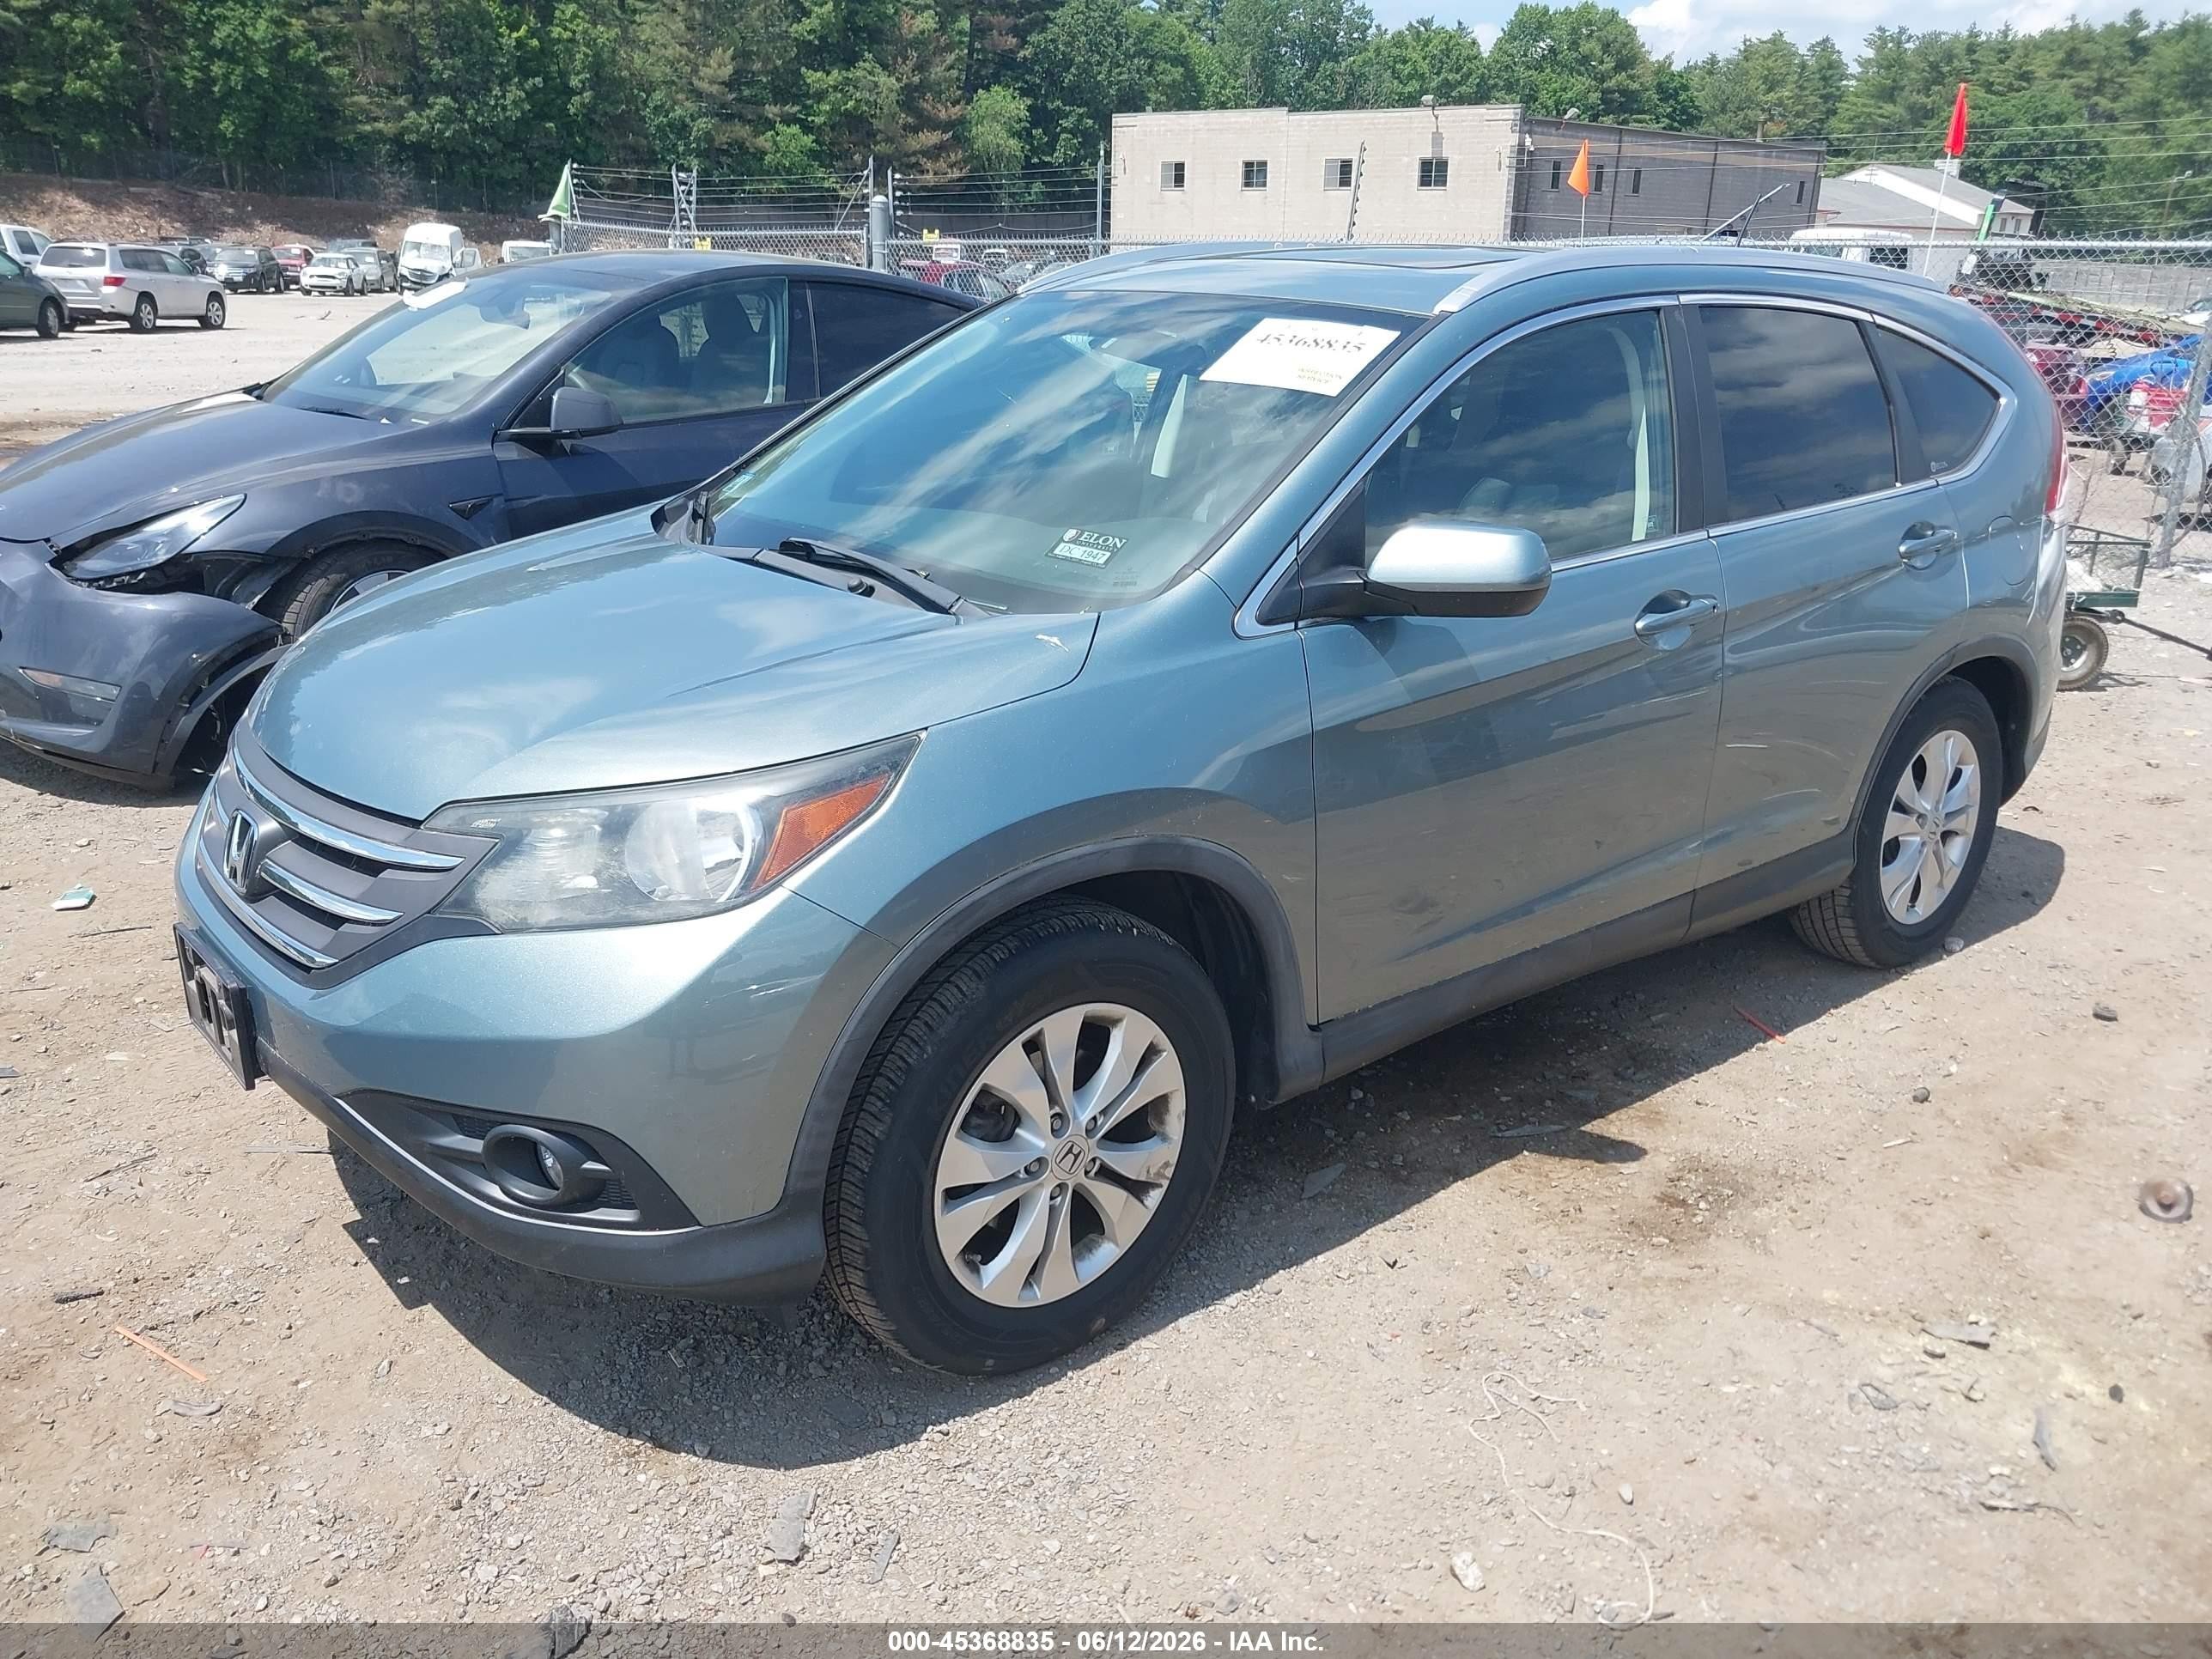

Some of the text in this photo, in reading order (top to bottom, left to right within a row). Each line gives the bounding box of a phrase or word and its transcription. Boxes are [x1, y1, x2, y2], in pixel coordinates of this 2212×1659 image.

[1256, 332, 1367, 354] 45368835
[1076, 540, 1118, 552] UNIVERSITY
[1078, 531, 1127, 549] ELON
[1080, 550, 1107, 562] 1947
